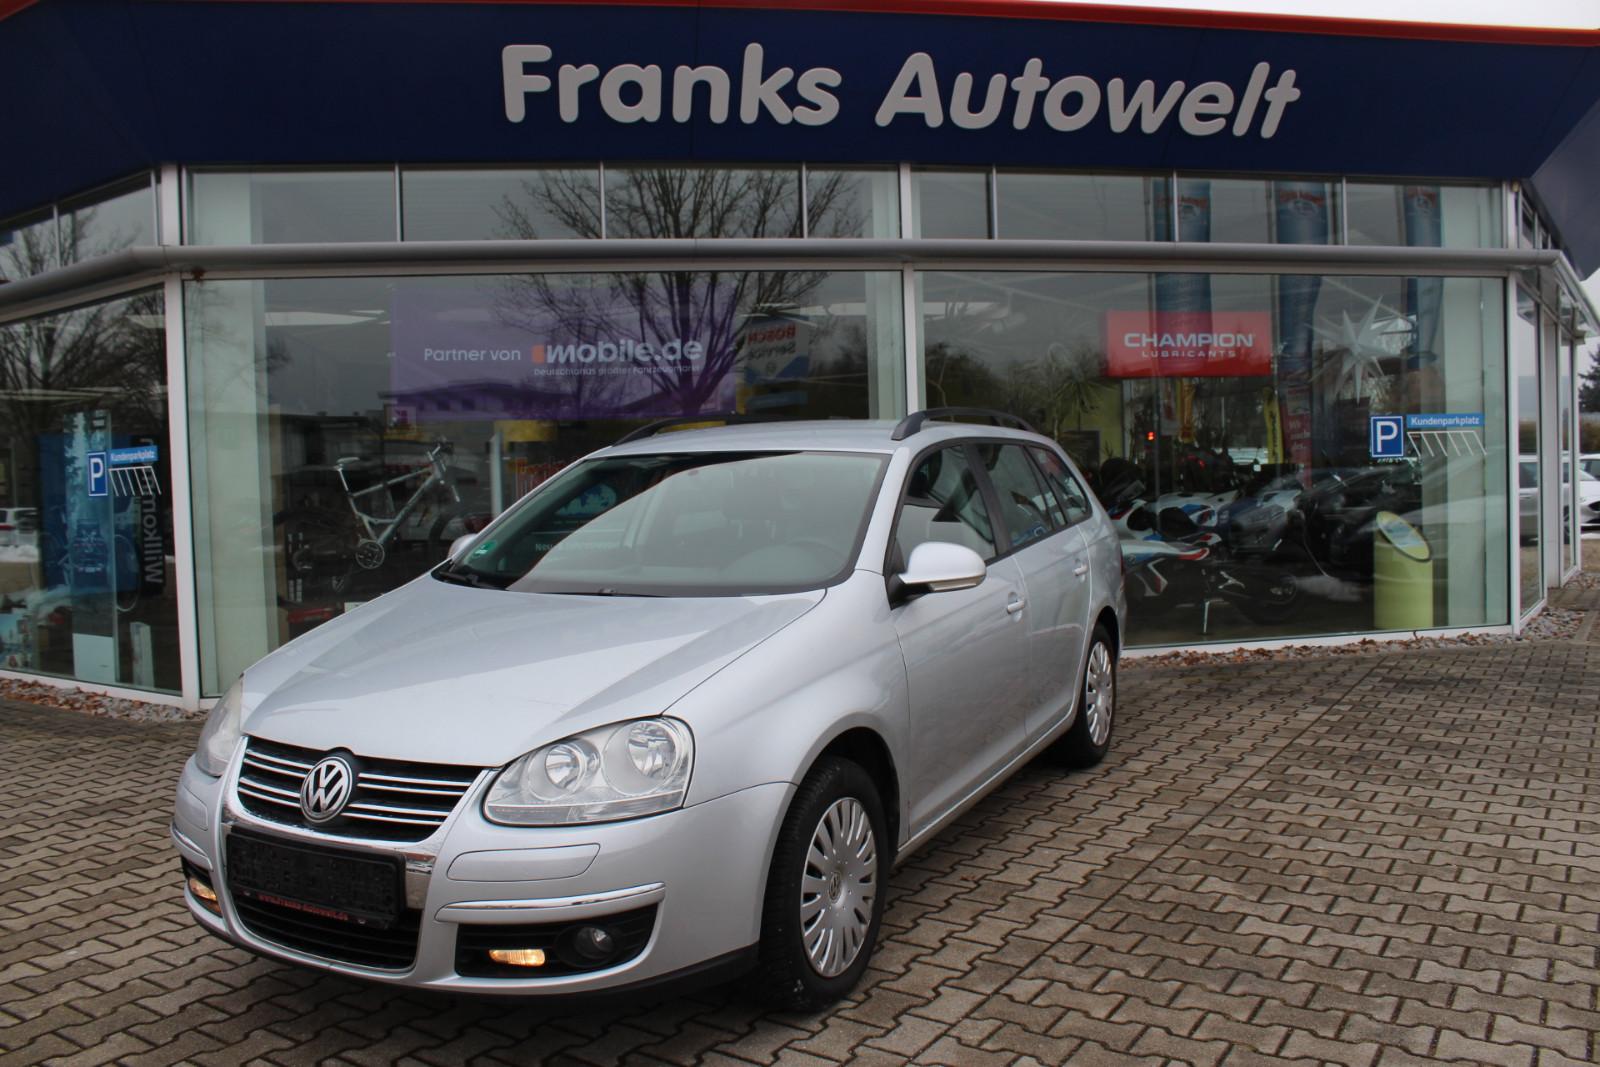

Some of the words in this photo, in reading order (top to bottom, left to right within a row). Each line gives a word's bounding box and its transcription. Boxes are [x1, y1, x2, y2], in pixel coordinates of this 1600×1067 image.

[502, 42, 842, 126] Franks
[874, 51, 1301, 139] Autowelt
[424, 347, 485, 361] Partner
[490, 349, 521, 361] von
[546, 338, 703, 363] mobile.de
[1124, 332, 1254, 347] CHAMPION
[1142, 350, 1237, 358] LUBRICANTS
[1411, 416, 1479, 426] Kundenparkplatz
[1376, 421, 1398, 453] P
[90, 457, 103, 491] P
